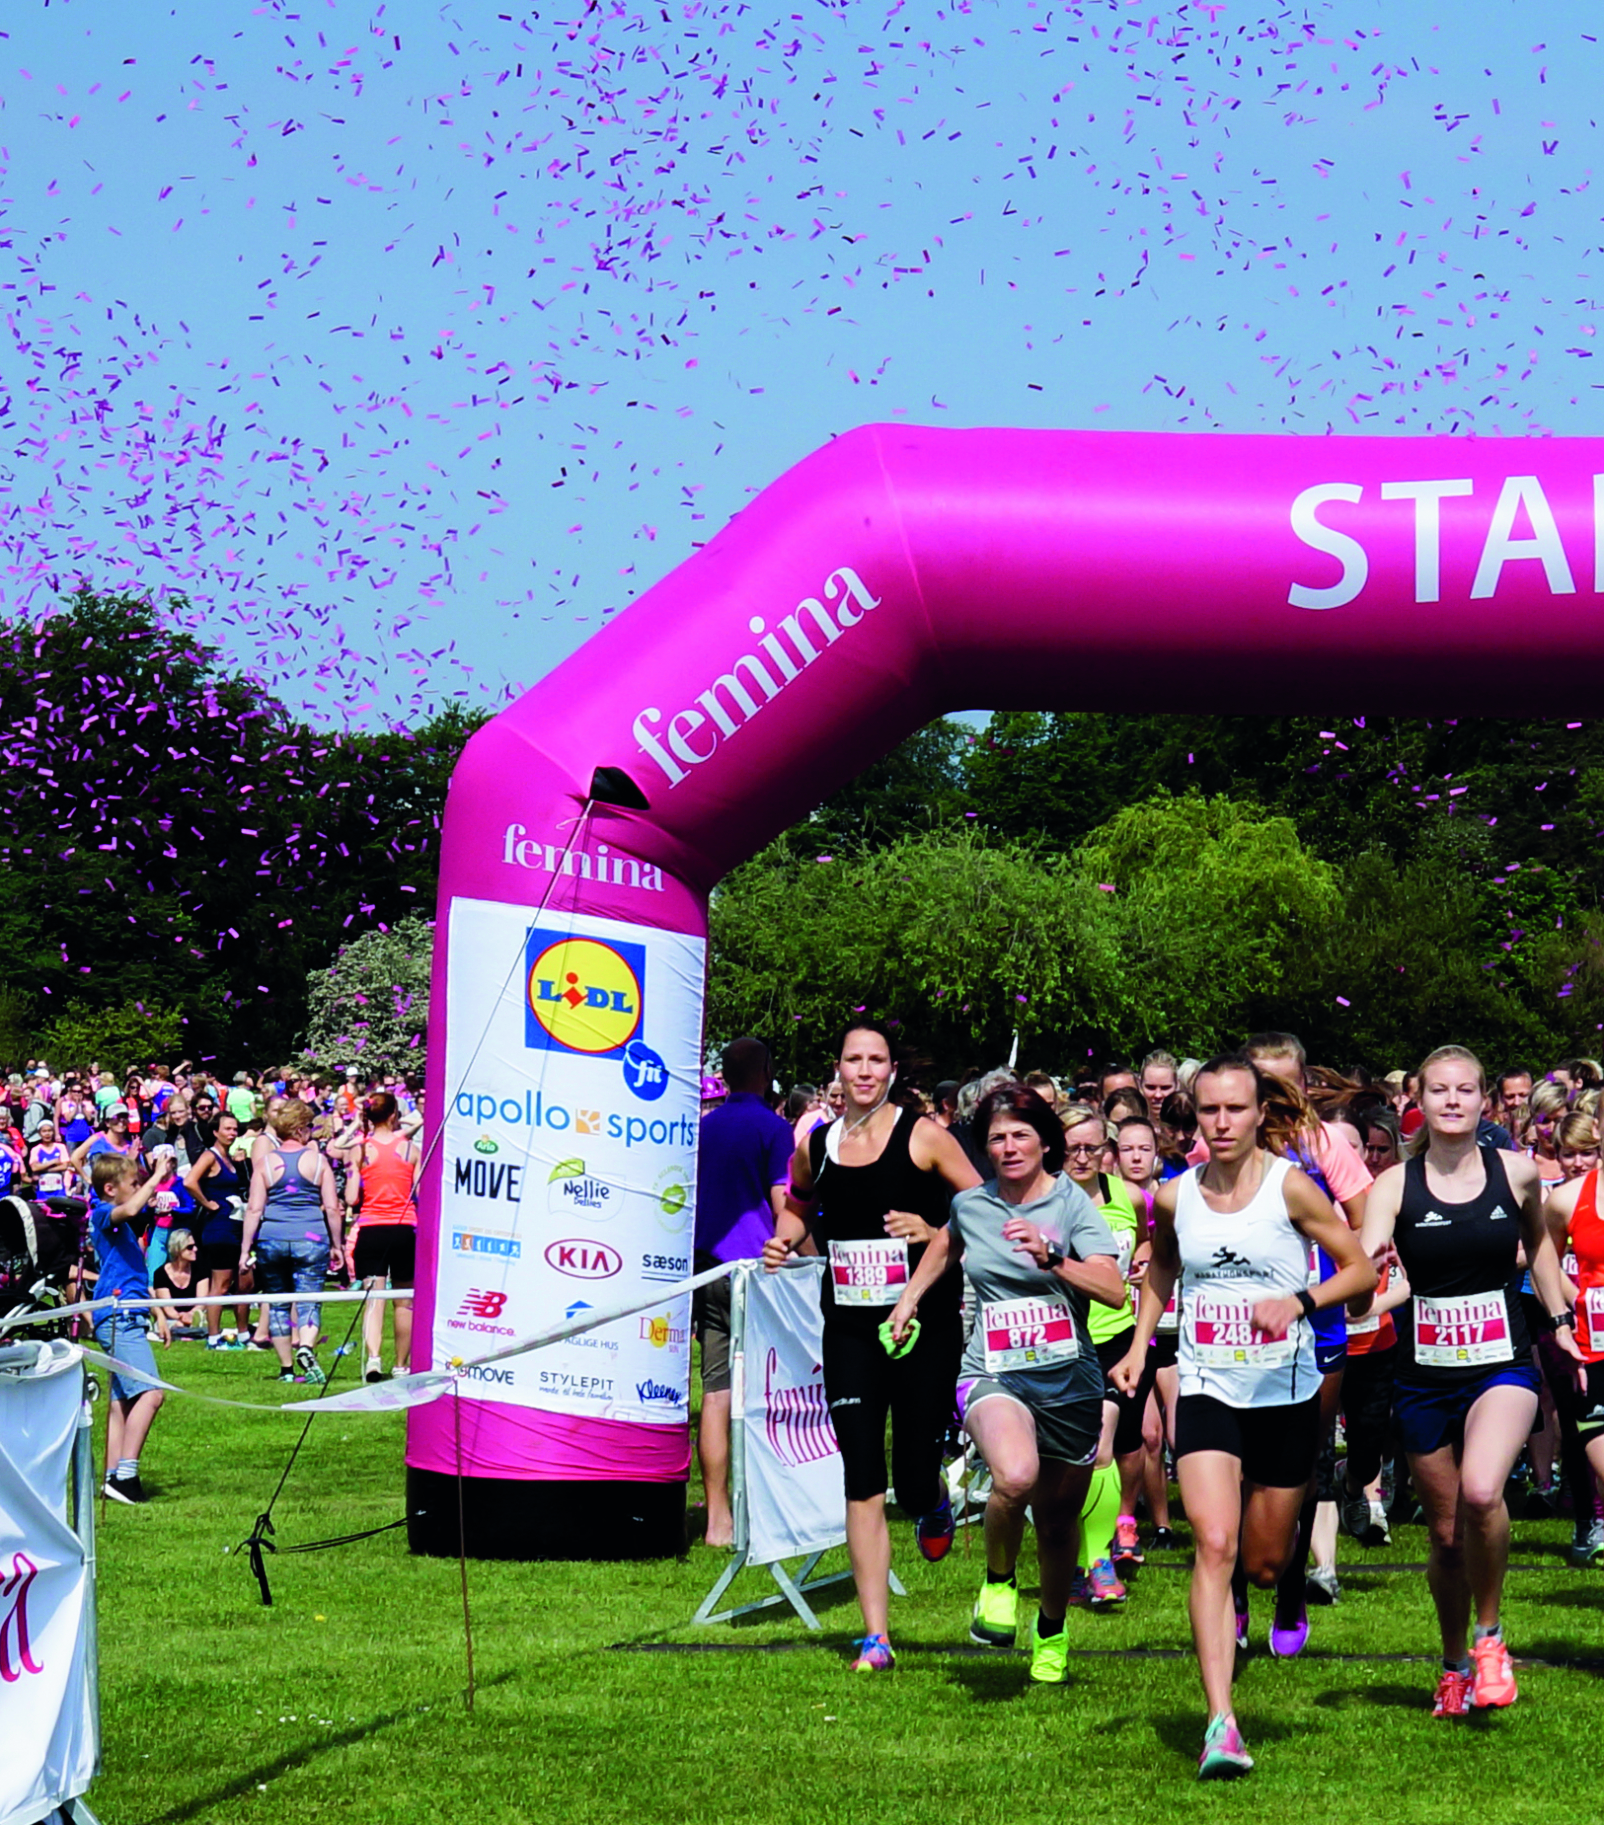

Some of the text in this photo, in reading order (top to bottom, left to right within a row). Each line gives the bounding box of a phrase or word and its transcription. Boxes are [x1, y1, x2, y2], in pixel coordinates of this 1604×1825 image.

[631, 565, 882, 789] femina
[502, 823, 665, 892] femina
[456, 1090, 694, 1148] apollo sports
[455, 1157, 521, 1203] MOVE
[563, 1180, 610, 1199] Nellie
[559, 1246, 610, 1272] KIA
[642, 1254, 688, 1271] sæson
[846, 1267, 888, 1286] 1389
[985, 1302, 1069, 1329] femina
[1196, 1294, 1249, 1320] femi
[1418, 1299, 1502, 1324] femina
[447, 1319, 466, 1329] new
[1008, 1325, 1048, 1348] 872
[1434, 1322, 1485, 1346] 2117
[558, 1336, 619, 1350] AGLIGE HUS
[540, 1371, 615, 1391] STYLEPIT
[765, 1347, 840, 1467] femin
